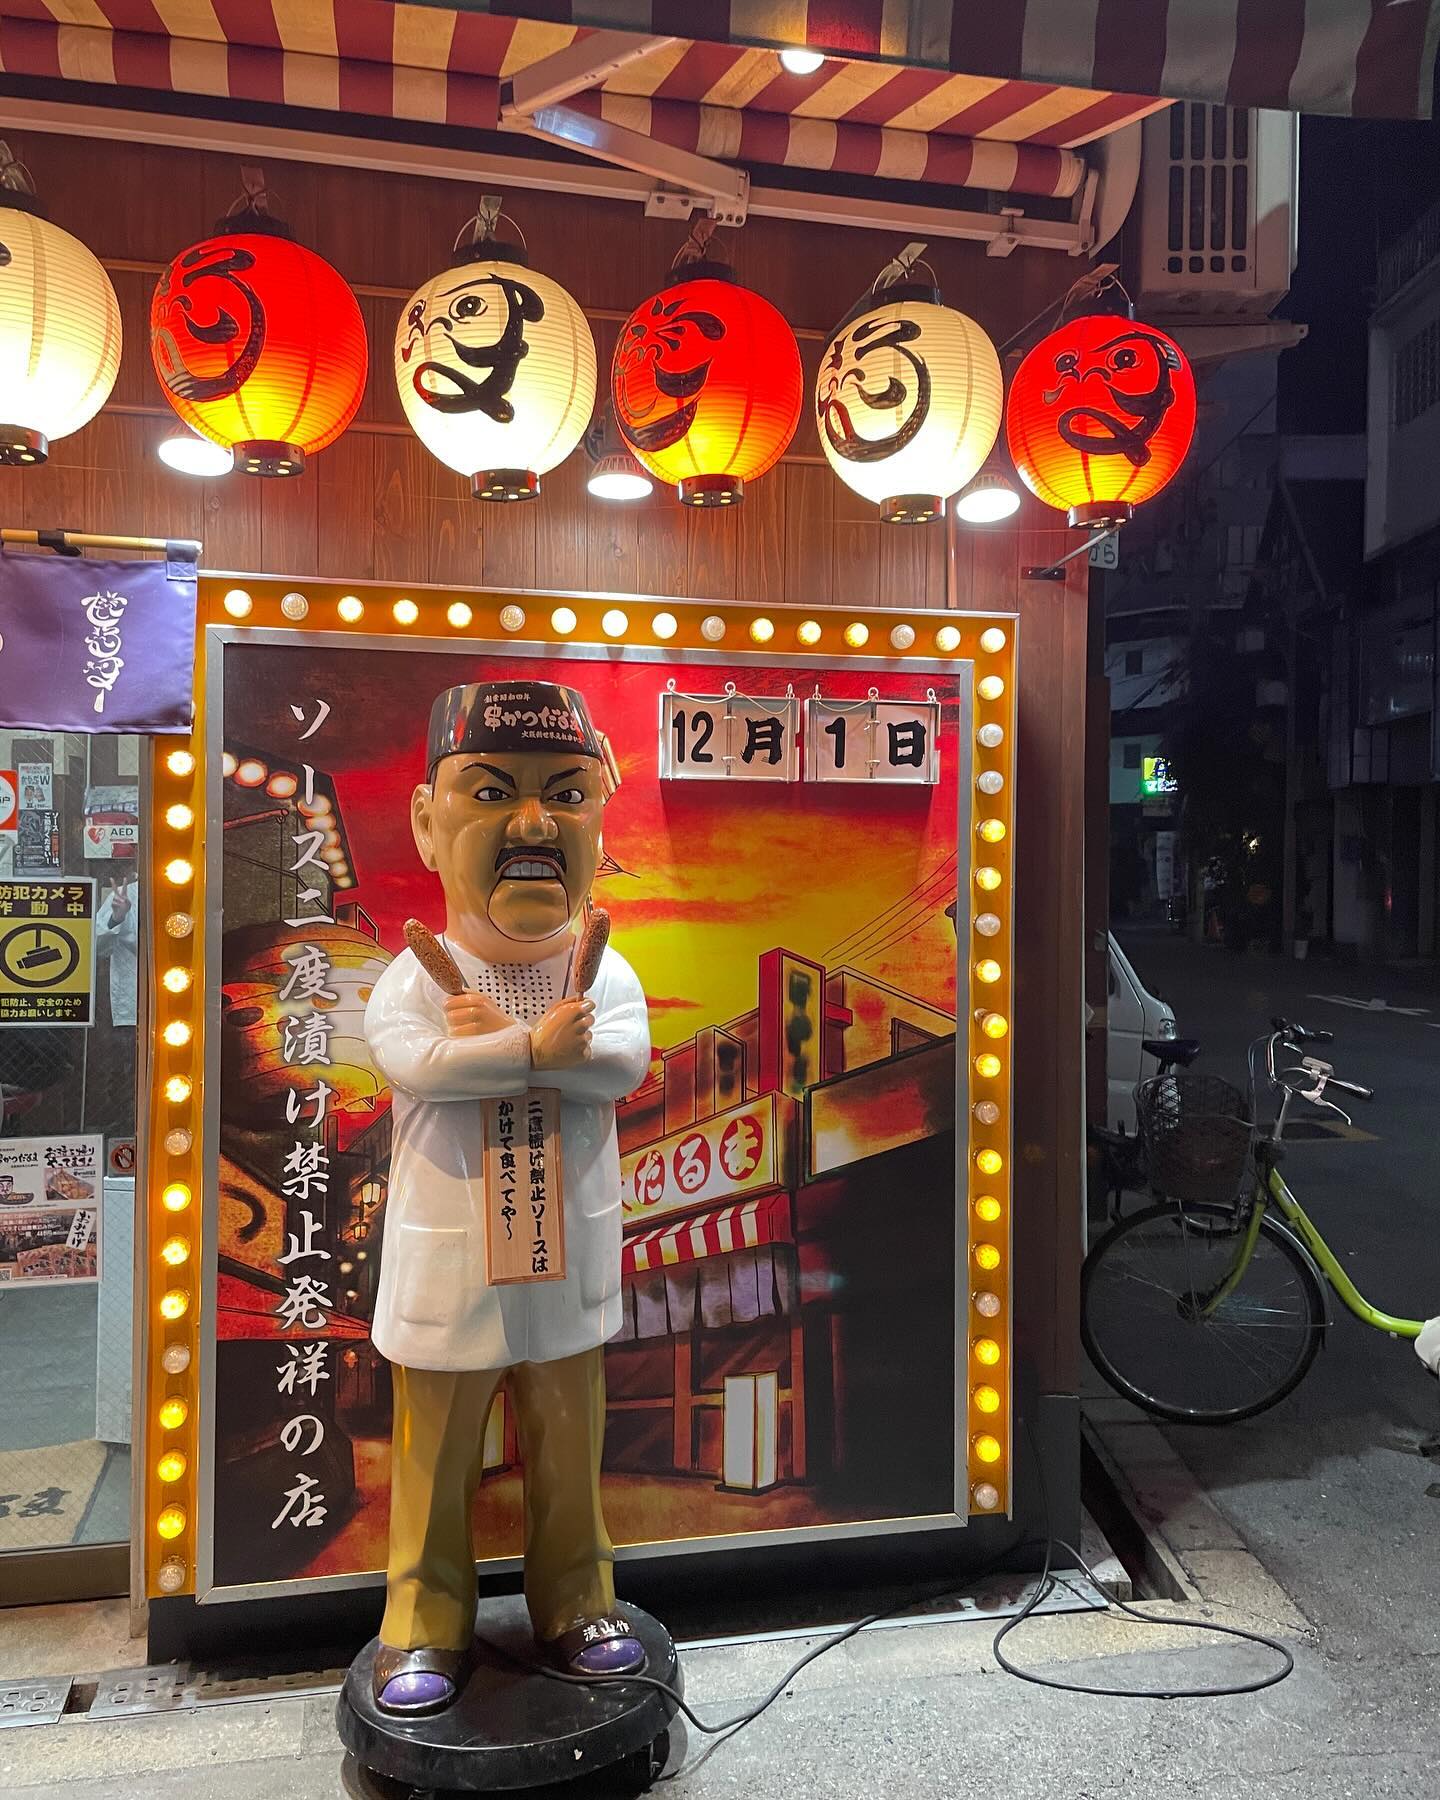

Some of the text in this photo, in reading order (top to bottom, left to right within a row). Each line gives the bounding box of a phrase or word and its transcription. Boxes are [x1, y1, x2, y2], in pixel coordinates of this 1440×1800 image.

[110, 827, 134, 836] AED
[271, 698, 338, 1530] ソース二度漬け禁止発祥の店
[637, 1118, 760, 1205] だるま
[527, 1101, 549, 1274] 二度漬け禁止ソースは
